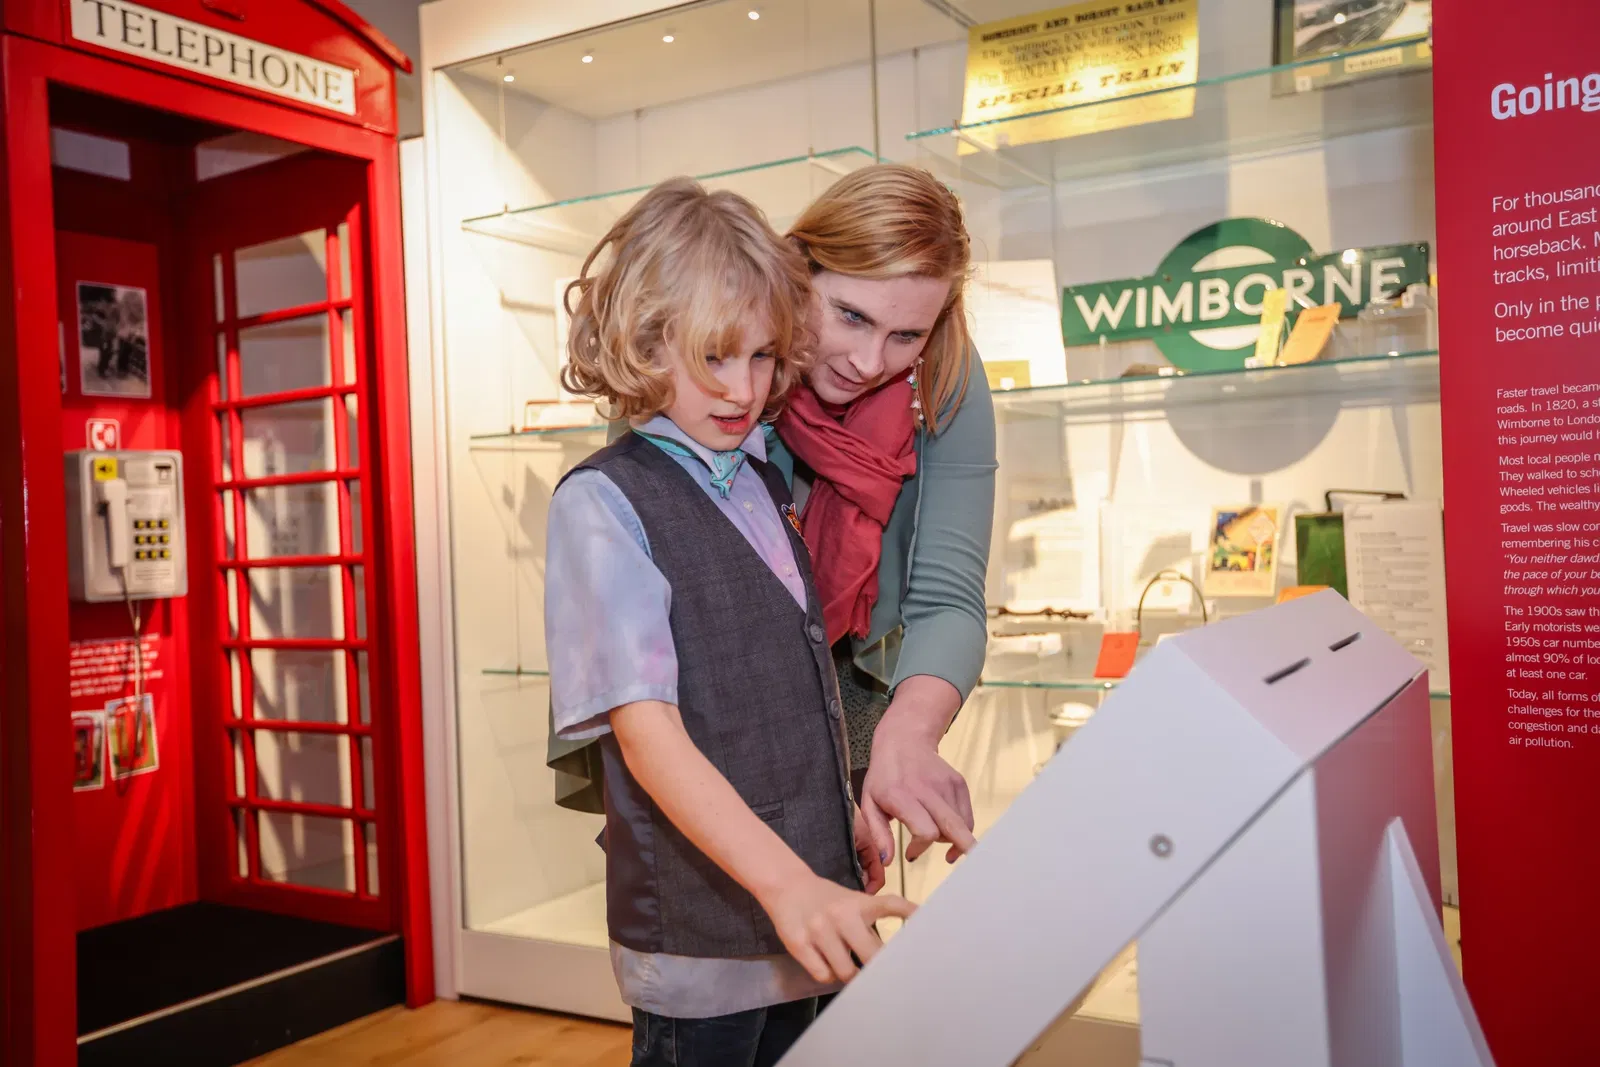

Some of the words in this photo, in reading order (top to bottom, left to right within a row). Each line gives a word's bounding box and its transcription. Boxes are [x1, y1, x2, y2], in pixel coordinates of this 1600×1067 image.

[1045, 17, 1069, 30] AND
[83, 0, 342, 105] TELEPHONE
[977, 80, 1083, 109] SPECIAL
[1100, 61, 1184, 87] TRAIN
[1491, 72, 1600, 120] Going
[1492, 196, 1520, 213] For
[1492, 213, 1552, 237] around
[1559, 207, 1598, 228] East
[1493, 234, 1586, 261] horseback.
[1493, 265, 1550, 285] tracks,
[1074, 257, 1406, 333] WIMBORNE
[1494, 300, 1533, 319] Only
[1539, 297, 1555, 314] in
[1560, 294, 1590, 311] the
[1495, 324, 1564, 343] become
[1569, 316, 1600, 338] qui
[1496, 387, 1528, 399] Faster
[1530, 384, 1559, 397] travel
[1562, 383, 1600, 394] becam
[1496, 403, 1528, 415] roads.
[1531, 402, 1542, 412] In
[1546, 399, 1579, 411] 1820,
[1582, 400, 1589, 408] a
[1497, 418, 1550, 430] Wimborne
[1553, 416, 1564, 426] to
[1498, 435, 1517, 446] this
[1519, 433, 1558, 446] journey
[1560, 429, 1593, 441] would
[1499, 455, 1524, 466] Most
[1527, 453, 1551, 465] local
[1554, 451, 1590, 465] people
[1499, 470, 1524, 483] They
[1526, 469, 1563, 480] walked
[1566, 468, 1578, 479] to
[1580, 467, 1600, 478] sch
[1499, 485, 1544, 497] Wheeled
[1546, 484, 1590, 495] vehicles
[1500, 501, 1533, 514] goods.
[1536, 500, 1557, 511] The
[1559, 499, 1600, 512] wealthy
[1500, 522, 1530, 533] Travel
[1533, 524, 1554, 532] was
[1556, 521, 1580, 532] slow
[1501, 538, 1571, 550] remembering
[1574, 537, 1590, 548] his
[1530, 553, 1568, 563] neither
[1503, 569, 1520, 580] the
[1522, 570, 1548, 581] pace
[1550, 569, 1562, 579] of
[1563, 570, 1587, 581] your
[1504, 585, 1544, 597] through
[1546, 585, 1578, 595] which
[1503, 605, 1524, 616] The
[1527, 605, 1563, 616] 1900s
[1564, 607, 1586, 617] saw
[1504, 621, 1530, 633] Early
[1533, 621, 1581, 633] motorists
[1506, 636, 1541, 647] 1950s
[1543, 639, 1559, 648] car
[1505, 652, 1540, 663] almost
[1543, 652, 1570, 664] 90%
[1572, 653, 1584, 665] of
[1506, 668, 1516, 678] at
[1519, 668, 1544, 679] least
[1546, 670, 1566, 679] one
[1568, 671, 1588, 680] car.
[1507, 688, 1539, 701] Today,
[1542, 690, 1555, 700] all
[1557, 691, 1589, 702] forms
[1507, 705, 1563, 718] challenges
[1565, 706, 1581, 717] for
[1583, 708, 1600, 719] the
[1508, 720, 1564, 733] congestion
[1567, 723, 1588, 734] and
[1508, 734, 1522, 745] air
[1525, 737, 1574, 749] pollution.
